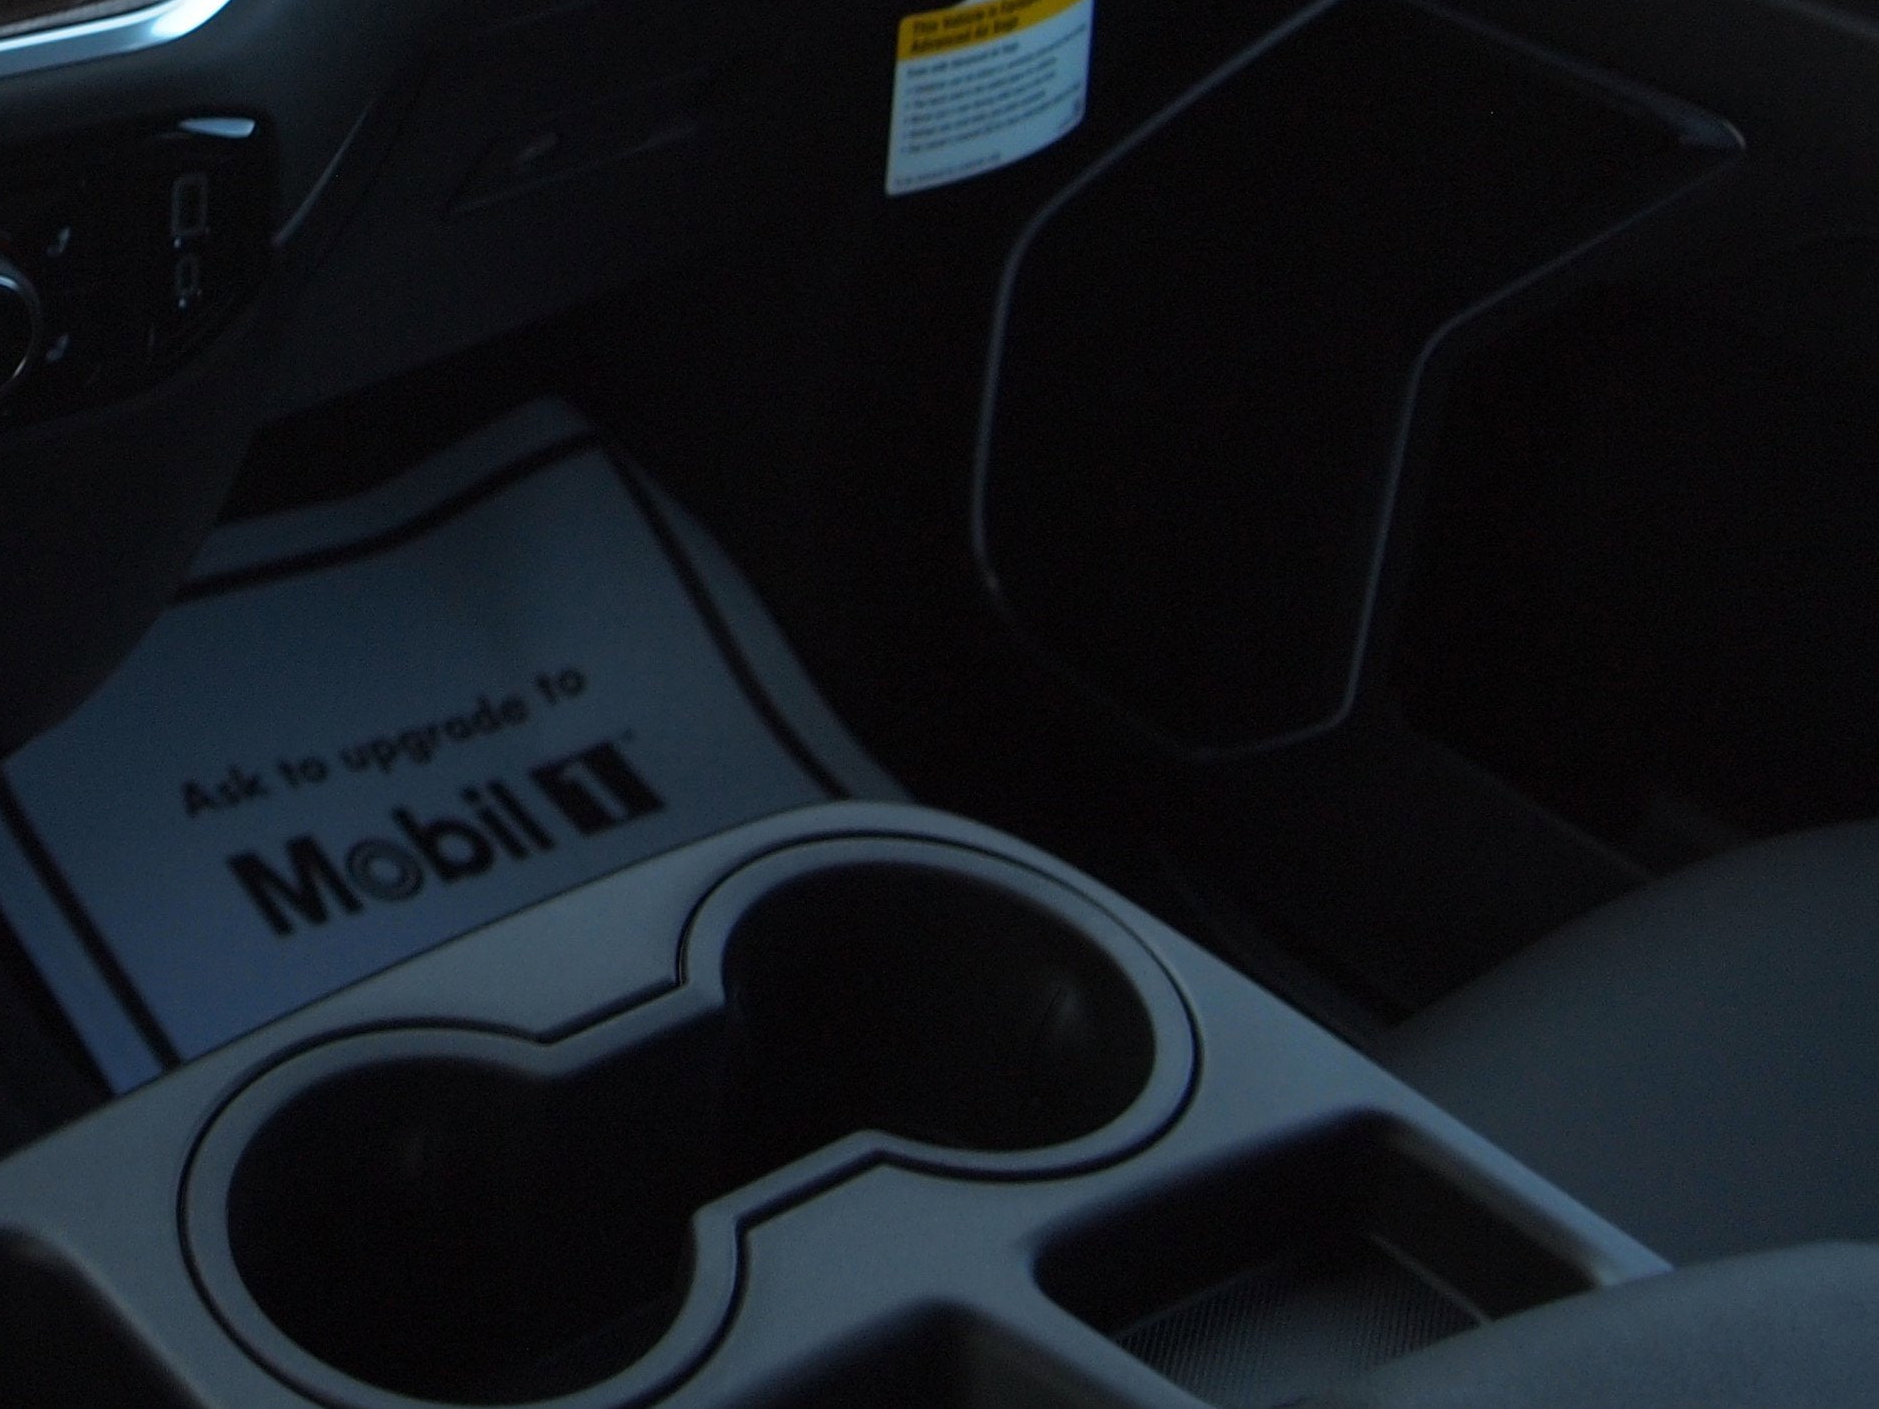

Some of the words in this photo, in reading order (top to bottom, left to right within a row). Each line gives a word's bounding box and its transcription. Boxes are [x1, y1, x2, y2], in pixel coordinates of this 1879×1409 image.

[181, 764, 267, 818] Ask
[278, 755, 328, 787] to
[339, 693, 531, 774] upgrade
[534, 667, 587, 705] to
[227, 781, 555, 937] Mobil
